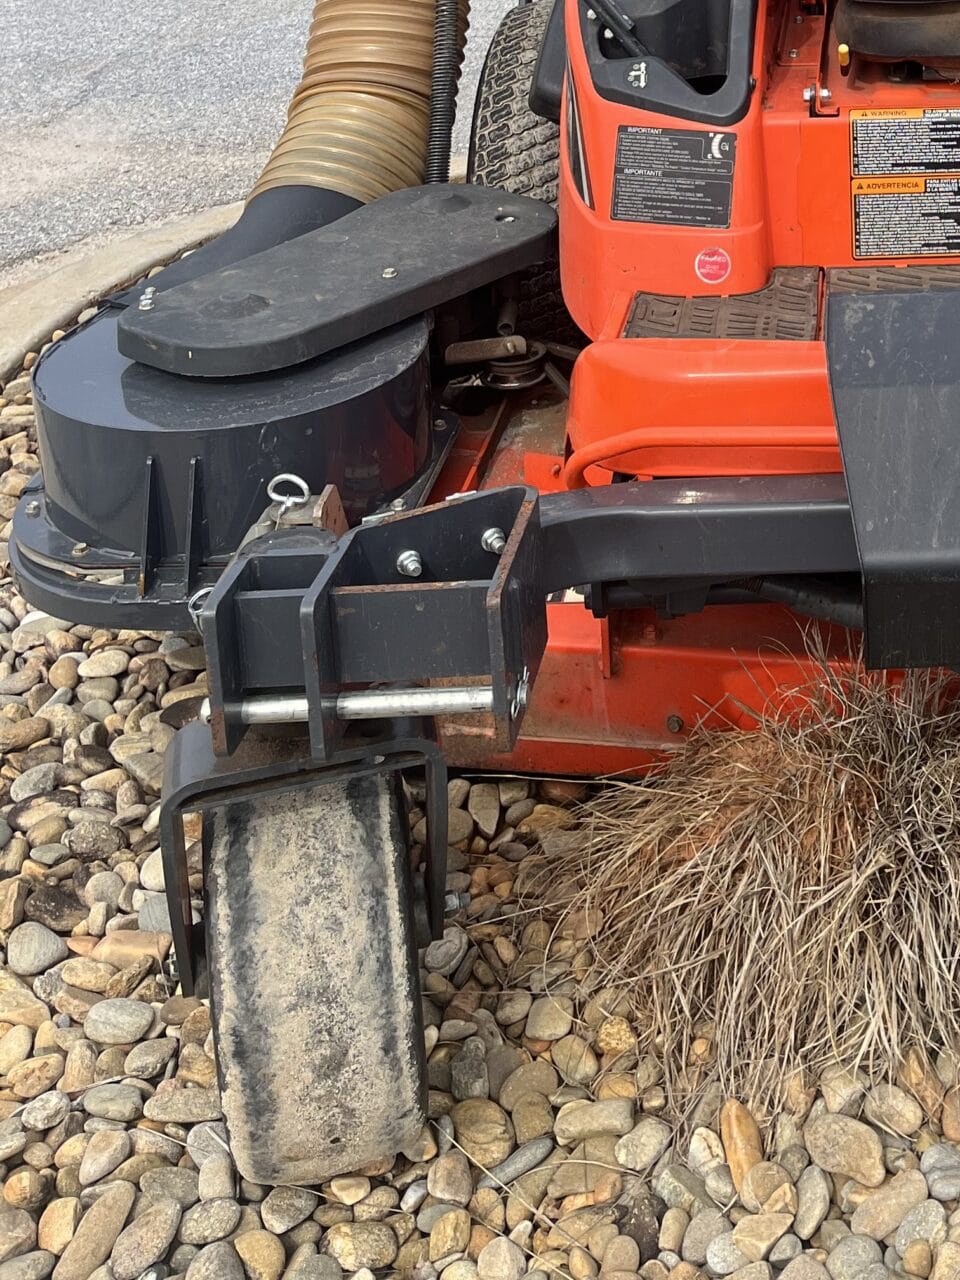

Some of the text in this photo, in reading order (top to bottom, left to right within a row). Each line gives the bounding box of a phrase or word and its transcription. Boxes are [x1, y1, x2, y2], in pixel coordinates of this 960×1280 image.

[628, 126, 662, 134] IMPORTANT
[624, 168, 662, 176] IMPORTANTE
[866, 182, 920, 190] ADVERTENCIA
